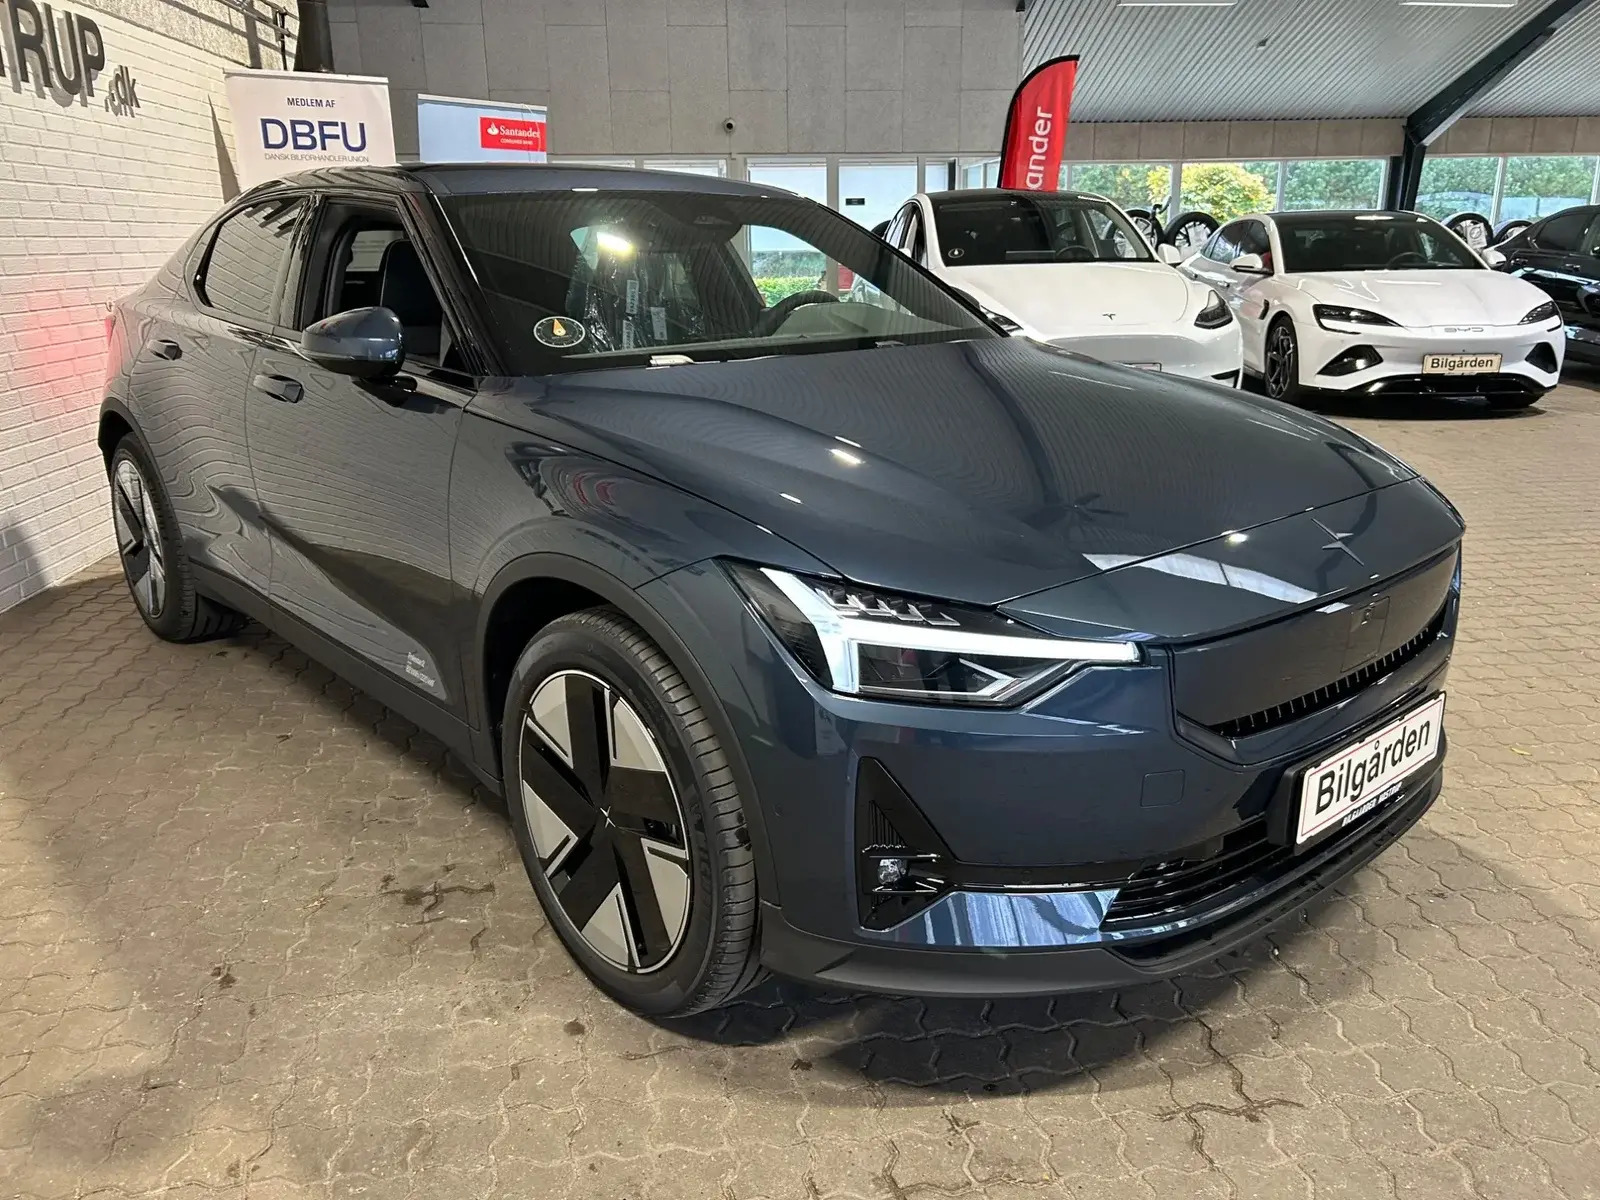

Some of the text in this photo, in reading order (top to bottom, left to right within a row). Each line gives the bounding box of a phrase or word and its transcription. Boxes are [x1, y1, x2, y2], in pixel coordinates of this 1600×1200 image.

[287, 97, 335, 108] MEDLEM AF
[260, 118, 367, 152] DBFU
[500, 125, 540, 138] Santander
[264, 153, 289, 161] DANSK
[1431, 356, 1493, 371] Bilgården
[1315, 720, 1431, 816] Bilgården
